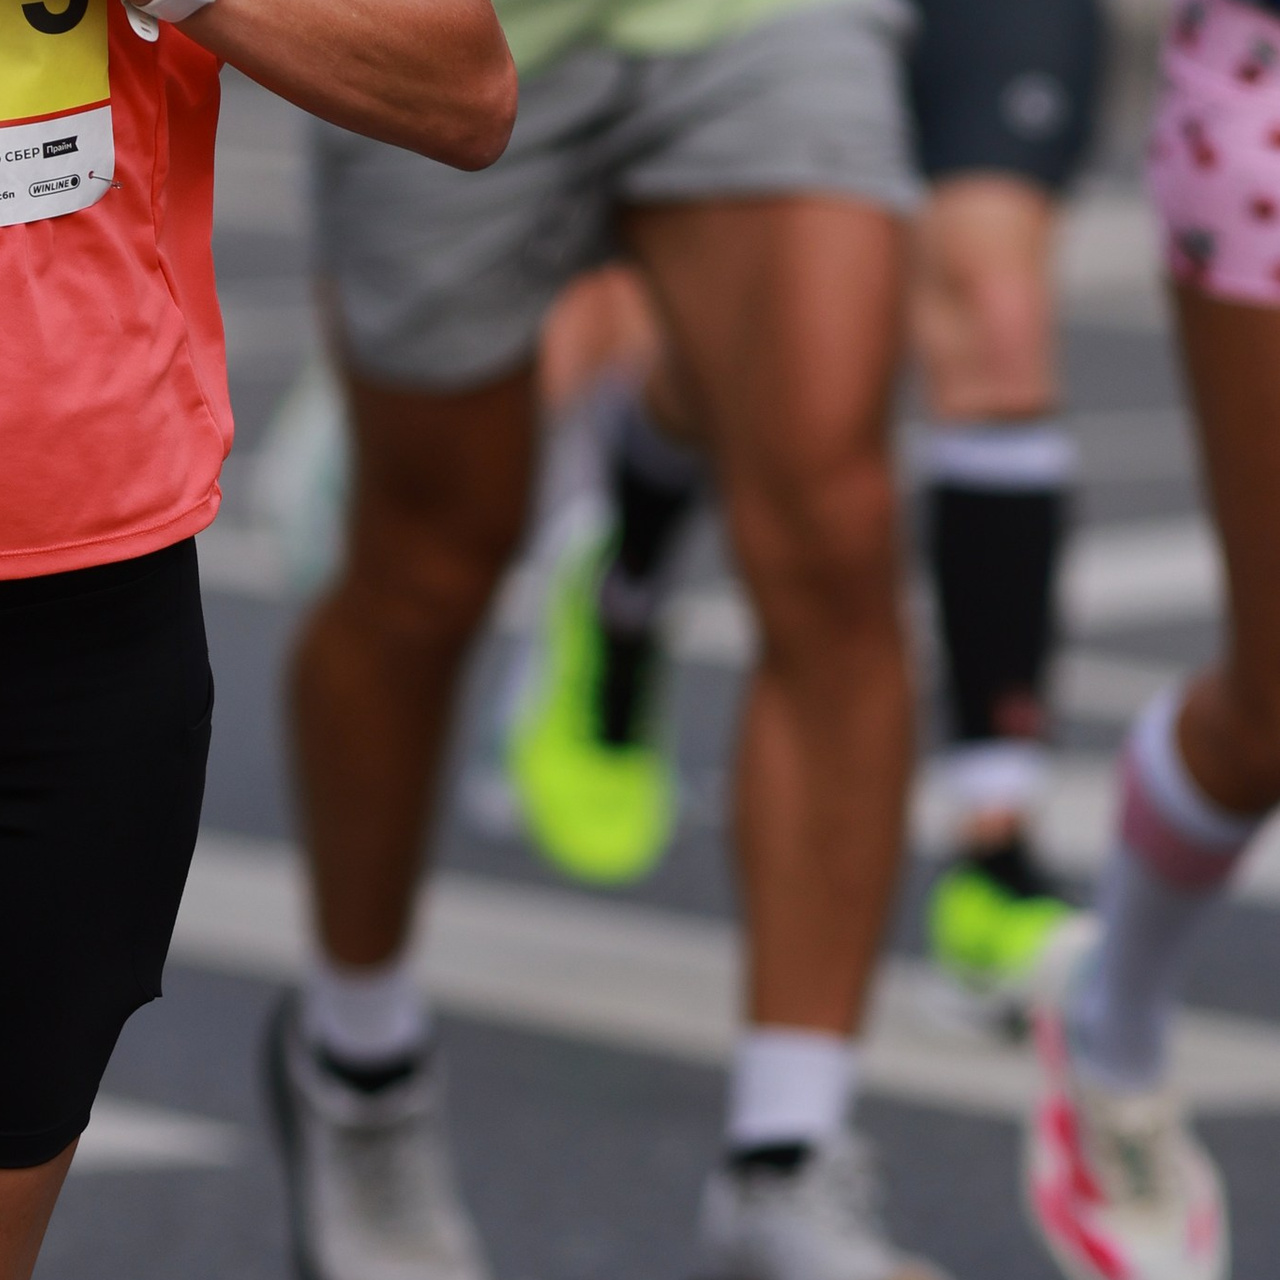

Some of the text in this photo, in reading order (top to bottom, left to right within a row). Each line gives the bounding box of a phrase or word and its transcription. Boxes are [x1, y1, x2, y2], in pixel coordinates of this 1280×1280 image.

[5, 141, 73, 162] СБЕР Прайм
[33, 179, 70, 194] WINLINE
